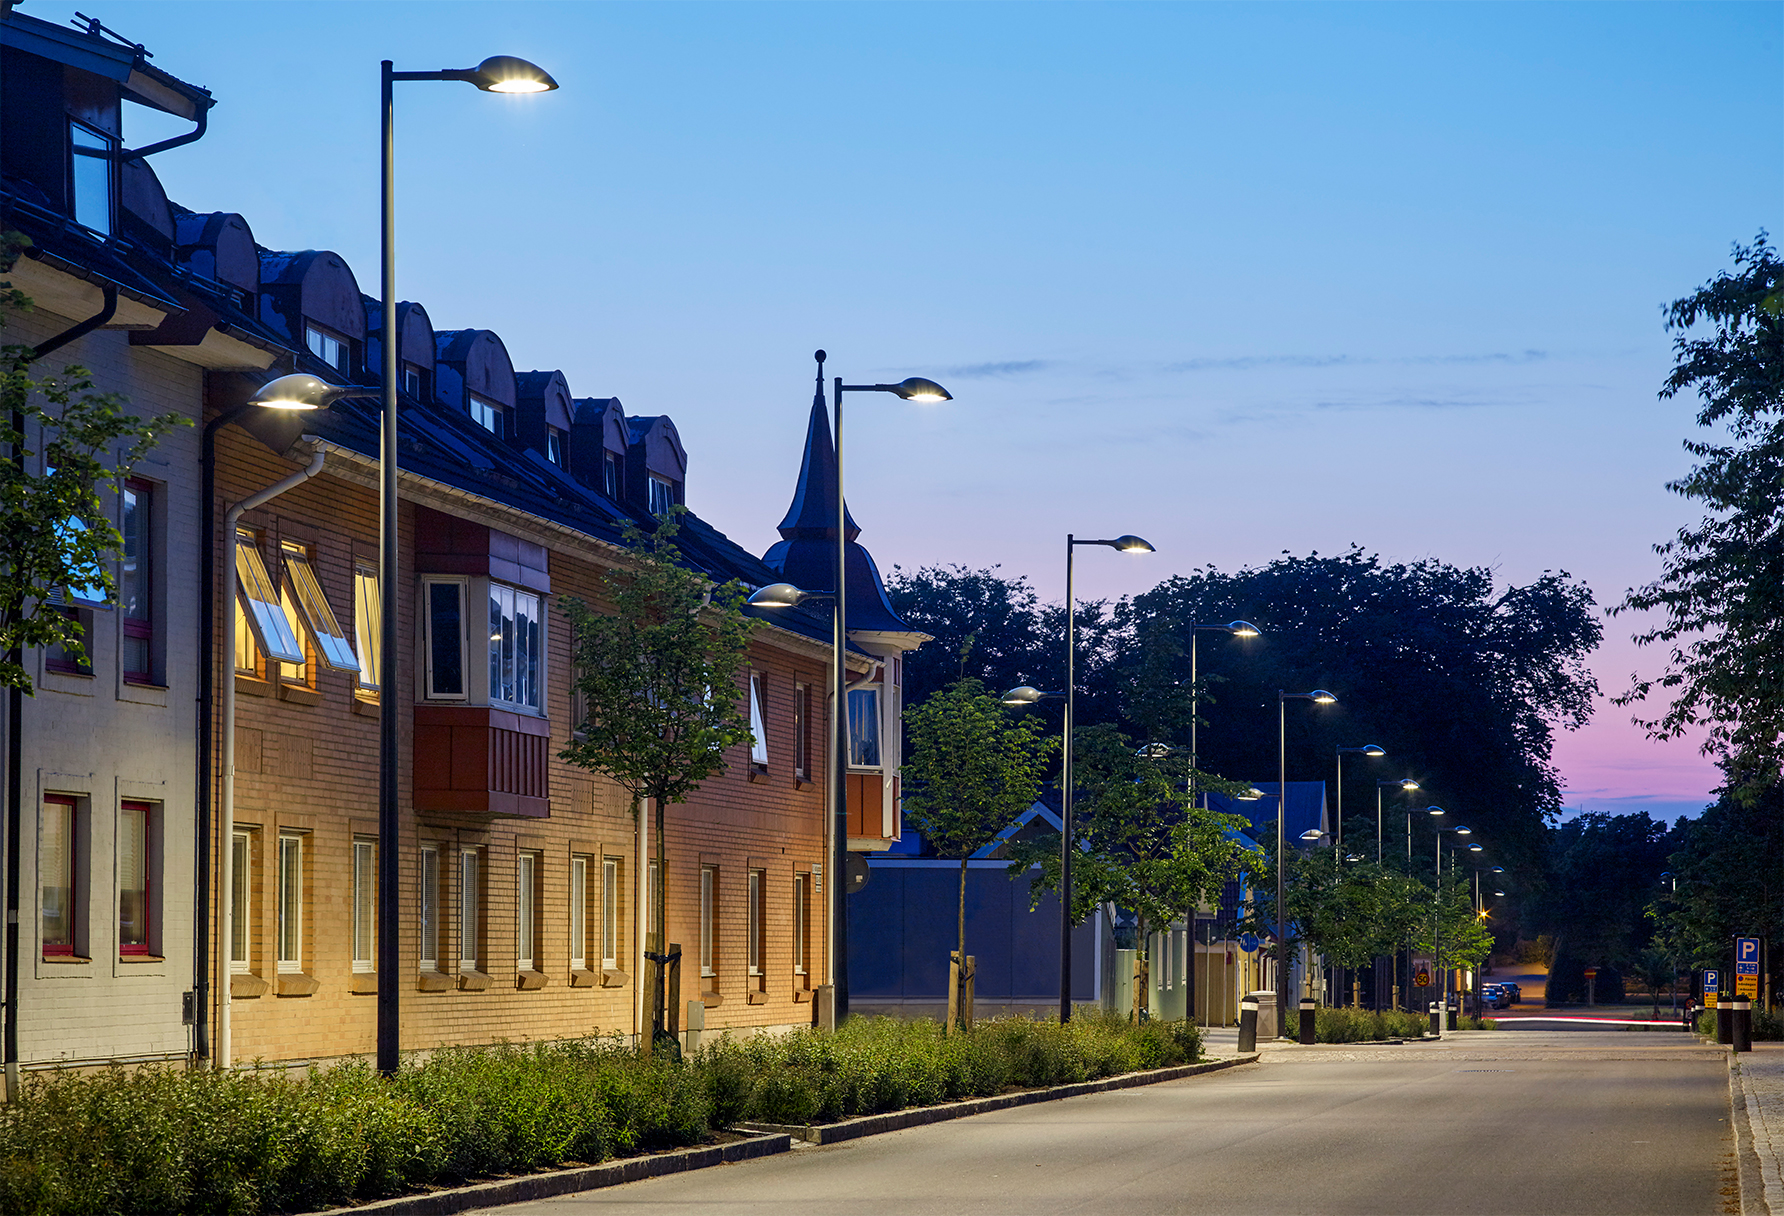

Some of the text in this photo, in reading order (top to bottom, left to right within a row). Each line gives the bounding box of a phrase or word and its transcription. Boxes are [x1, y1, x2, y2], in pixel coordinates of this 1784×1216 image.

[1743, 942, 1755, 958] P
[1419, 975, 1427, 983] 50
[1708, 973, 1715, 983] P
